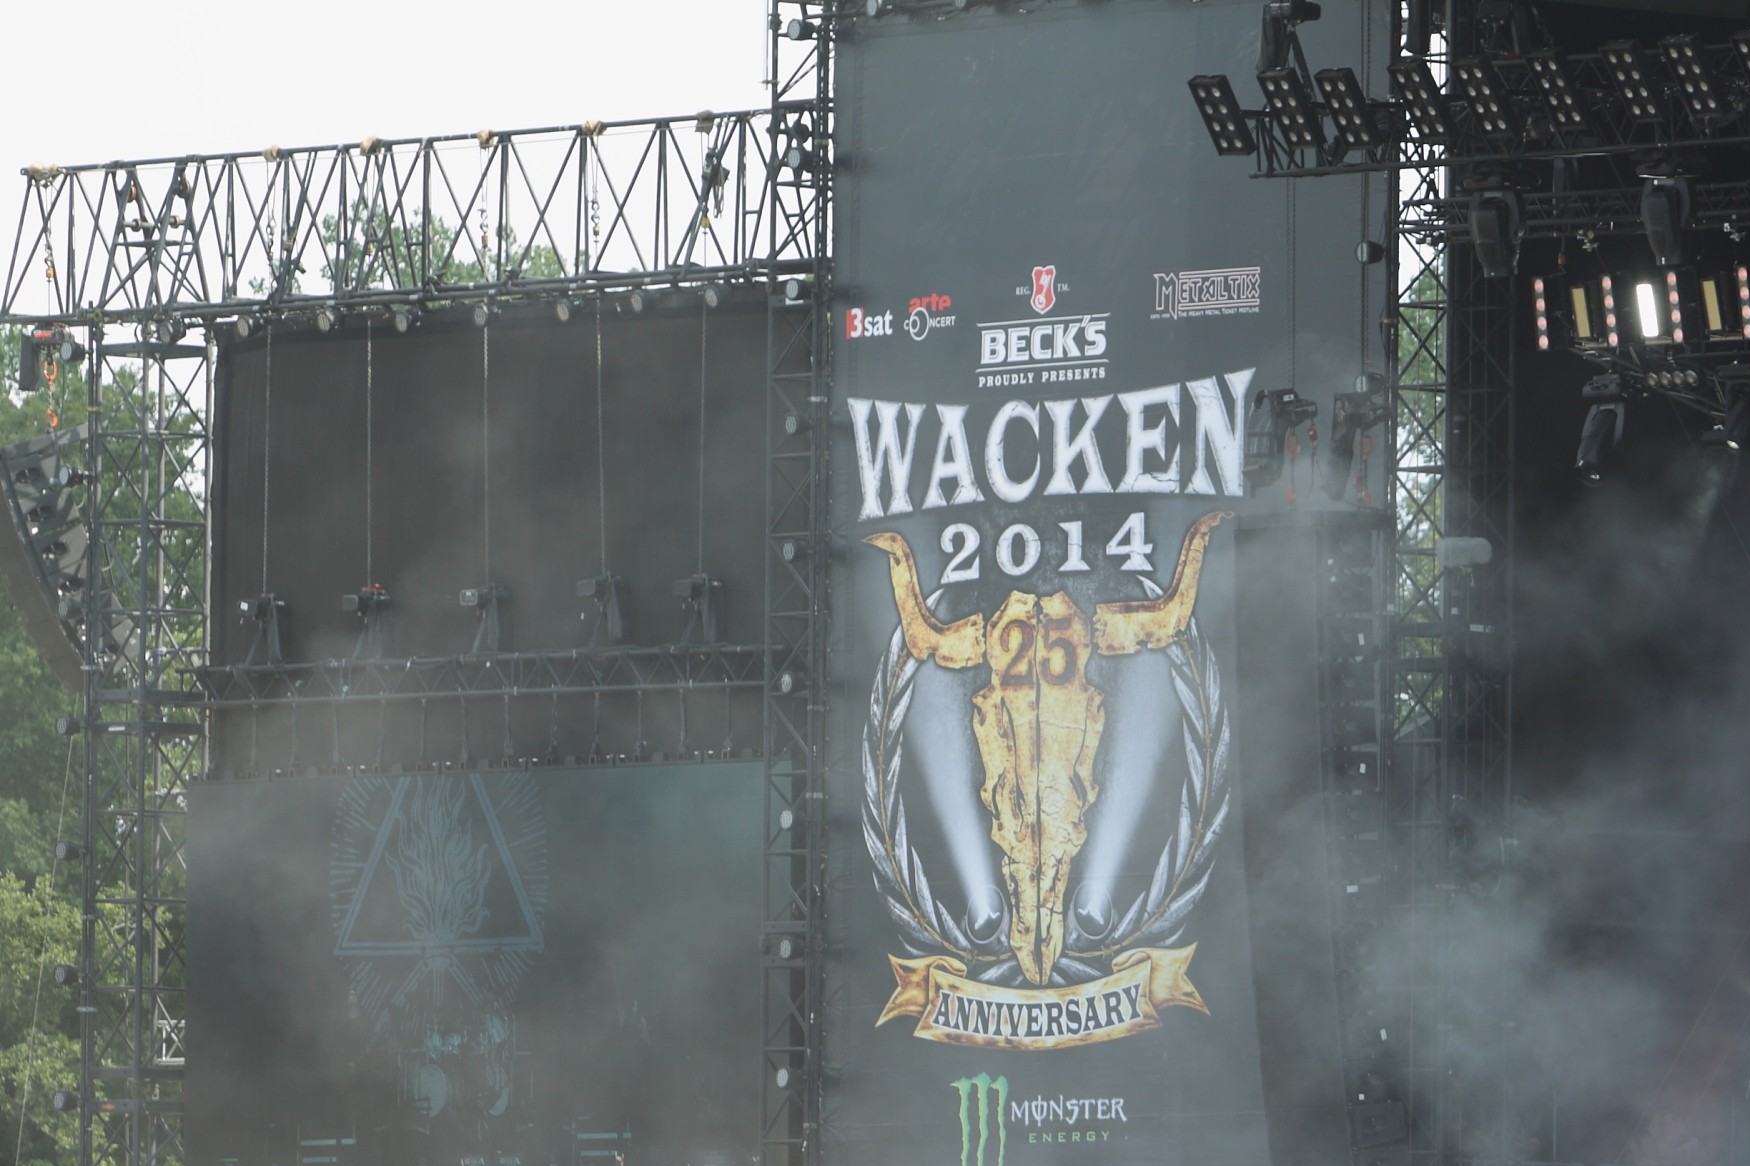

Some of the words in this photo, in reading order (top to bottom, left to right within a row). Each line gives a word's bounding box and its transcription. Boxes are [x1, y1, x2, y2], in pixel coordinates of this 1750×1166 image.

[909, 293, 952, 313] arte
[1153, 271, 1260, 320] METALTIX
[850, 307, 893, 338] 3sat
[980, 315, 1107, 364] BECK'S
[978, 372, 1035, 388] PROUDLY
[1041, 366, 1106, 383] PRESENTS
[846, 368, 1257, 523] WACKEN
[940, 511, 1154, 585] 2014
[1000, 616, 1077, 686] 25
[931, 981, 1143, 1039] ANNIVERSARY
[1028, 1130, 1111, 1144] ENERGY
